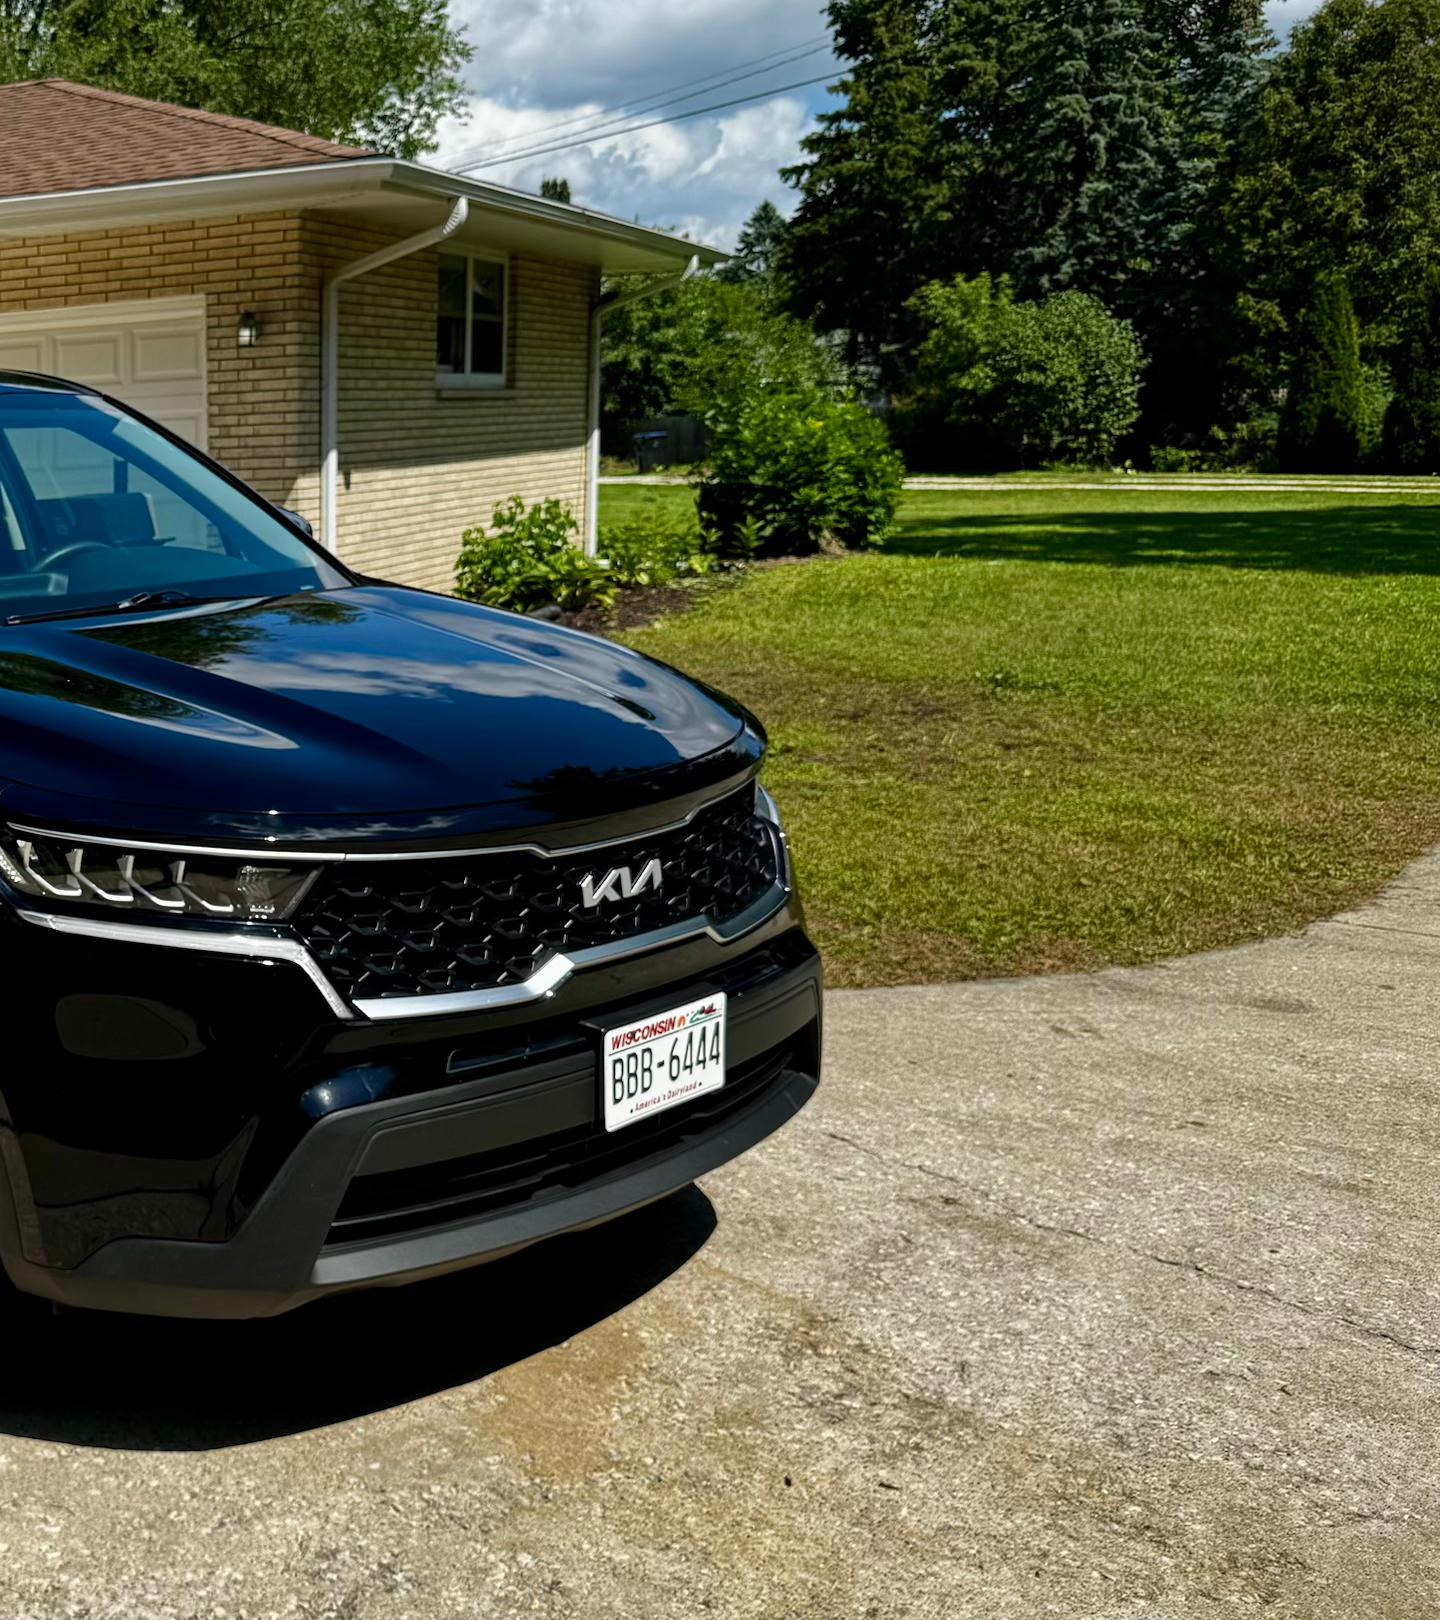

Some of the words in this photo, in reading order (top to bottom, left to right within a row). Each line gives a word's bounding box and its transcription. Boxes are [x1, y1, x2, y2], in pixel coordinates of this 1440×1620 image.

[580, 858, 662, 908] KIA
[611, 1016, 676, 1050] WISCONSIN
[612, 1021, 720, 1105] BBB-6444
[667, 1082, 697, 1098] Dairyland
